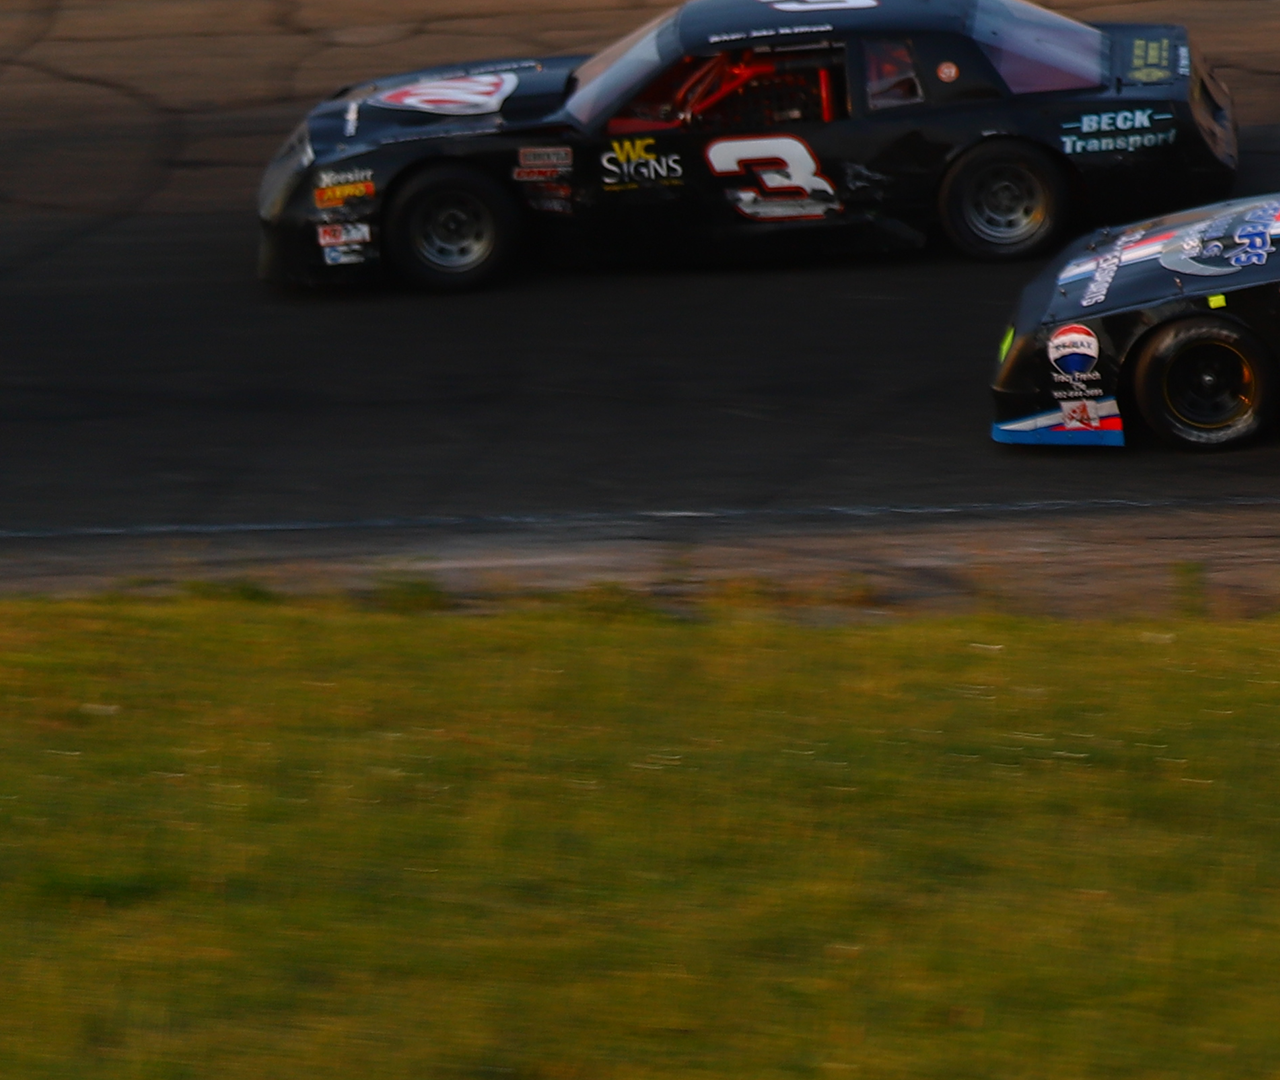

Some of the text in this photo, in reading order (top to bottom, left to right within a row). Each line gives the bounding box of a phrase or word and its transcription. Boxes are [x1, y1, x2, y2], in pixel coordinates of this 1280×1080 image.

[1080, 109, 1154, 133] BECK
[611, 137, 656, 162] WC
[1061, 129, 1177, 154] Transport
[601, 151, 683, 183] SIGNS
[704, 134, 844, 220] 3
